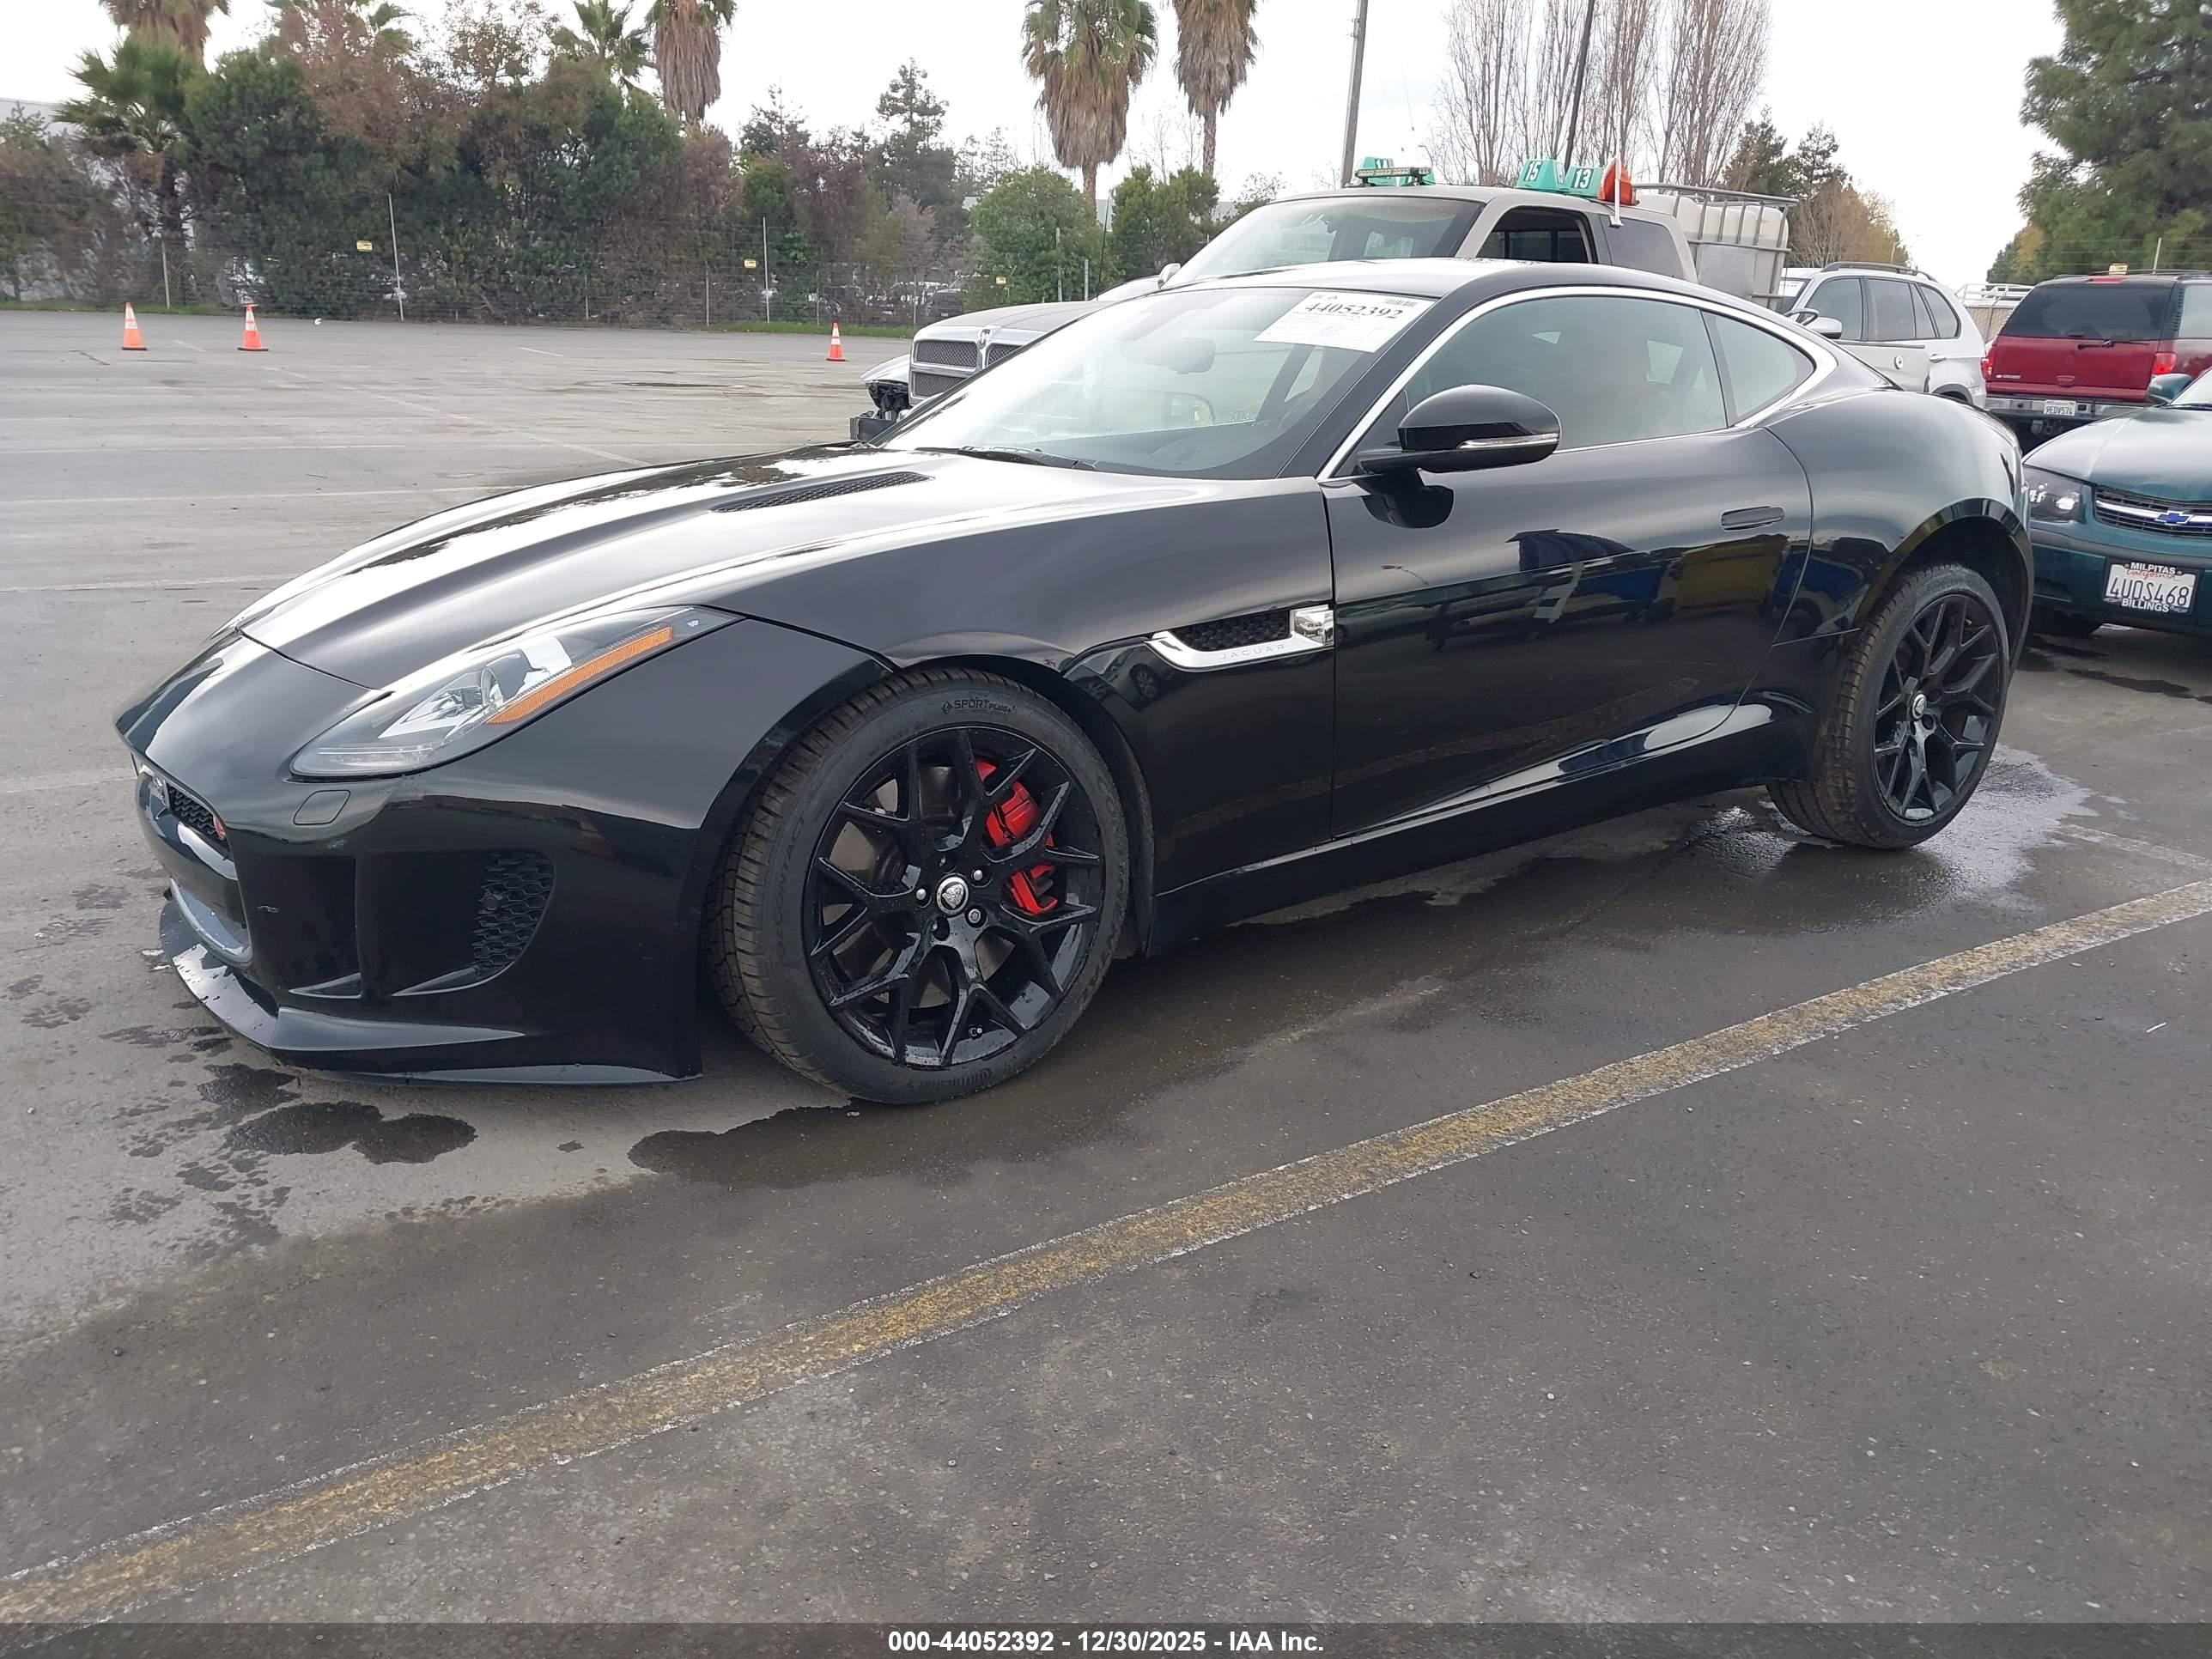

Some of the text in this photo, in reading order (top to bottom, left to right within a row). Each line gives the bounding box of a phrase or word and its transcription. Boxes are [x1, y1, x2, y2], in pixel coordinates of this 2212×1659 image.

[1524, 161, 1542, 181] 15
[1574, 168, 1591, 188] 13
[1305, 302, 1404, 319] 44052392
[2130, 562, 2176, 574] MILPITAS
[2121, 598, 2170, 613] BILLINGS
[1220, 644, 1285, 660] JAGUAR
